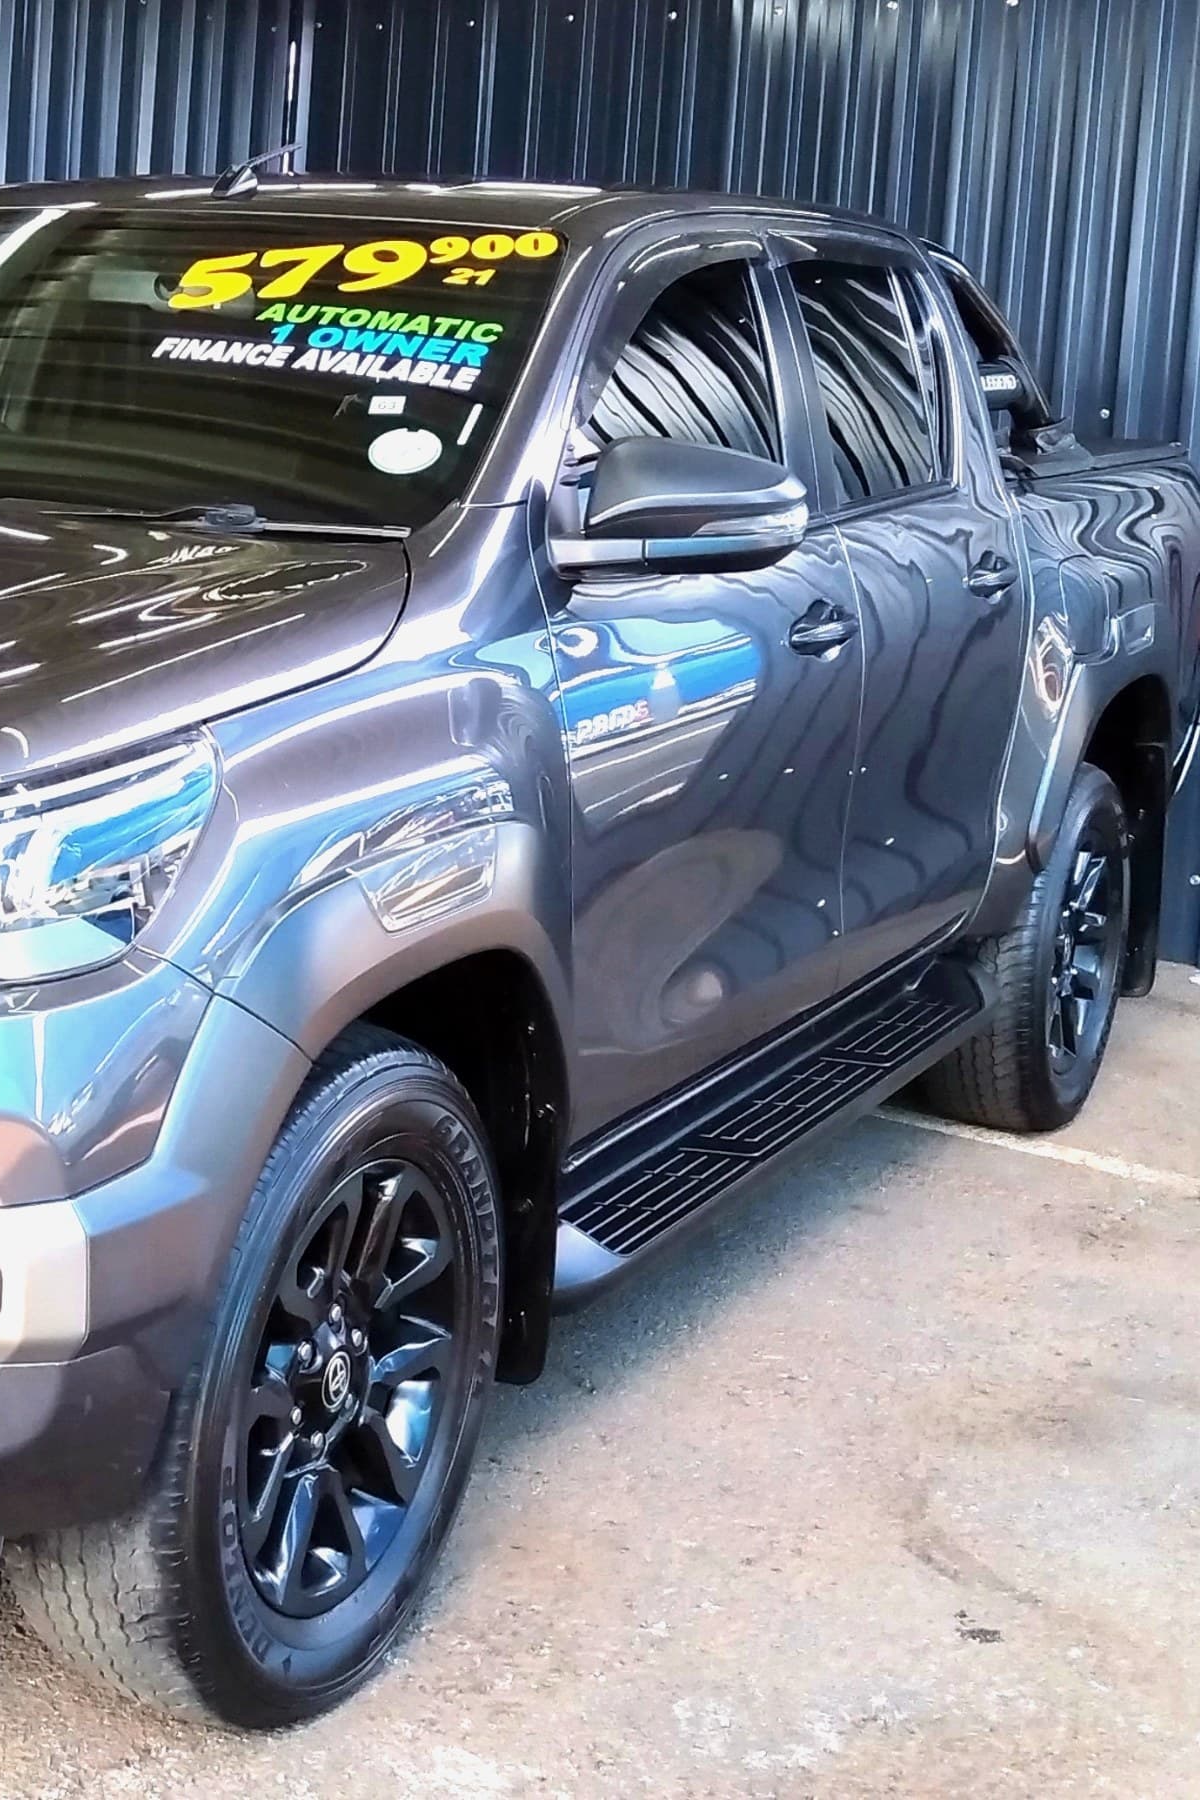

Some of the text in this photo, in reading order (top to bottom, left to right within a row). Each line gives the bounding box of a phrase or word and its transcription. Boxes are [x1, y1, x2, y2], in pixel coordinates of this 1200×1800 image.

[168, 232, 558, 309] 579 900
[443, 268, 495, 287] 21
[256, 303, 503, 342] AUTOMATIC
[152, 337, 482, 391] FINANCE AVAILABLE
[269, 324, 489, 367] 1 OWNER
